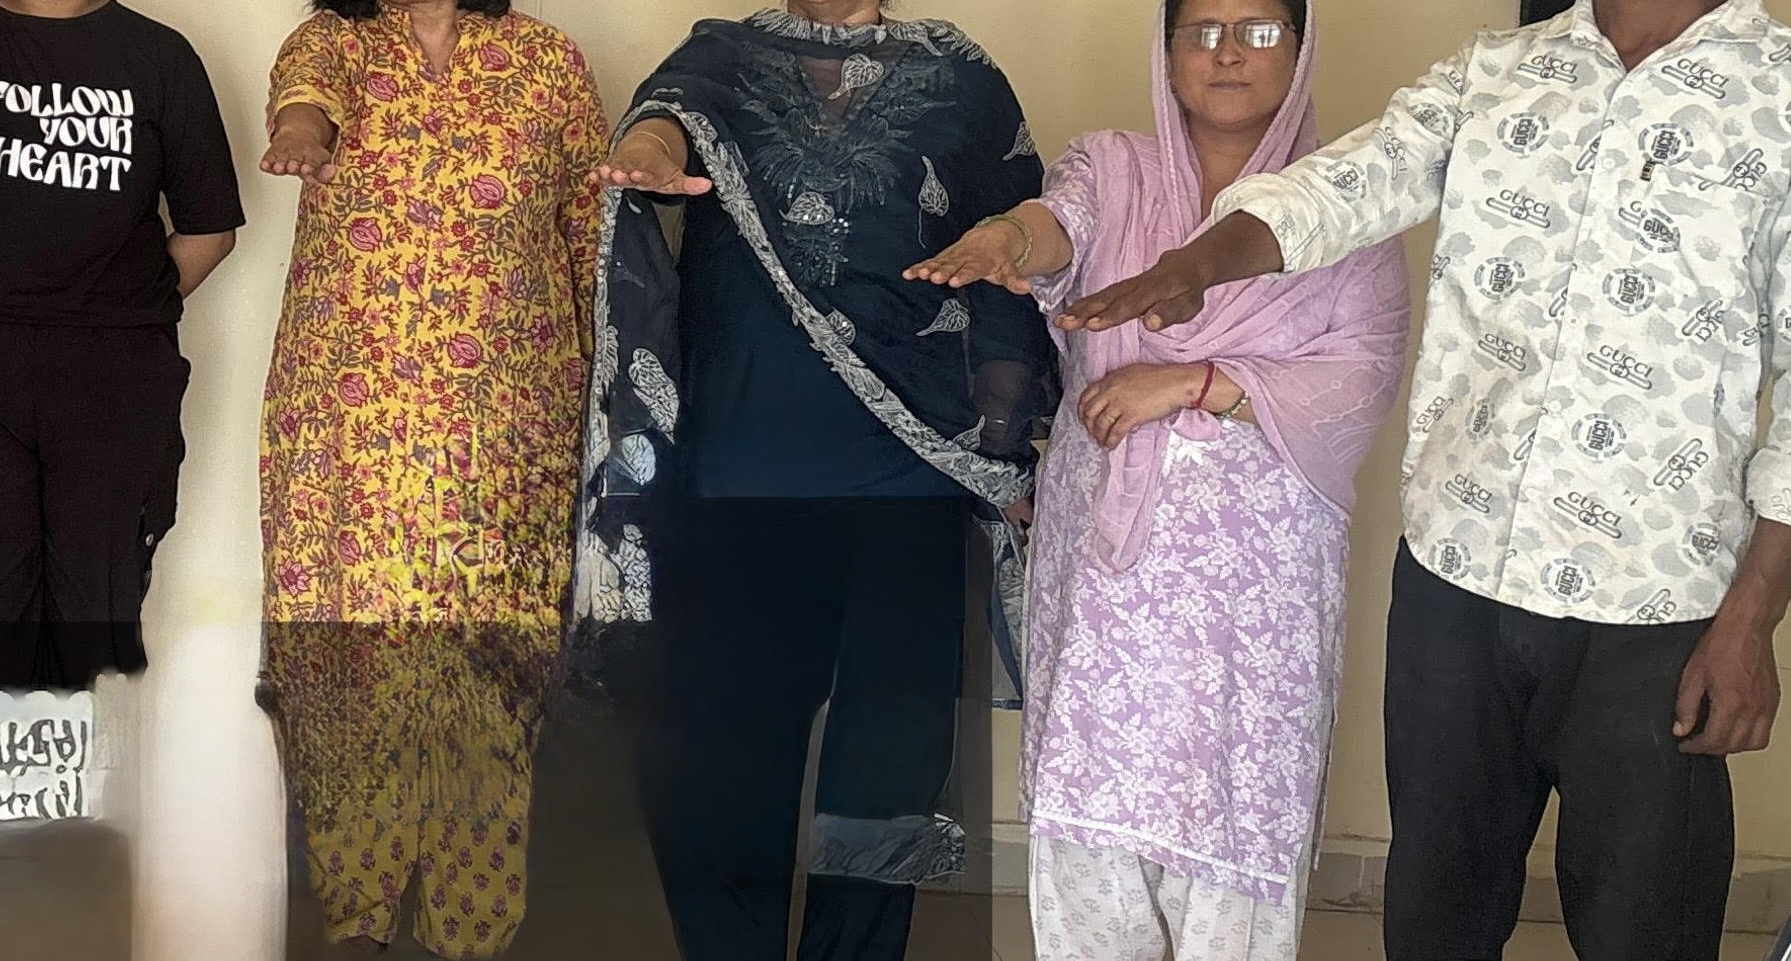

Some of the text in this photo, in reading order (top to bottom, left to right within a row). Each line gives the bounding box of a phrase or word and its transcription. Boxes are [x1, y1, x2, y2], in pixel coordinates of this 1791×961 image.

[1531, 55, 1577, 74] GUCCI
[1677, 58, 1729, 88] GUCCI
[39, 116, 133, 154] YOUR
[1500, 189, 1550, 217] GUCCI
[1600, 345, 1652, 378] GUCCI
[1668, 451, 1709, 491] GUCCI
[1454, 473, 1492, 502] GUCCI
[1567, 491, 1622, 527] GUCCI
